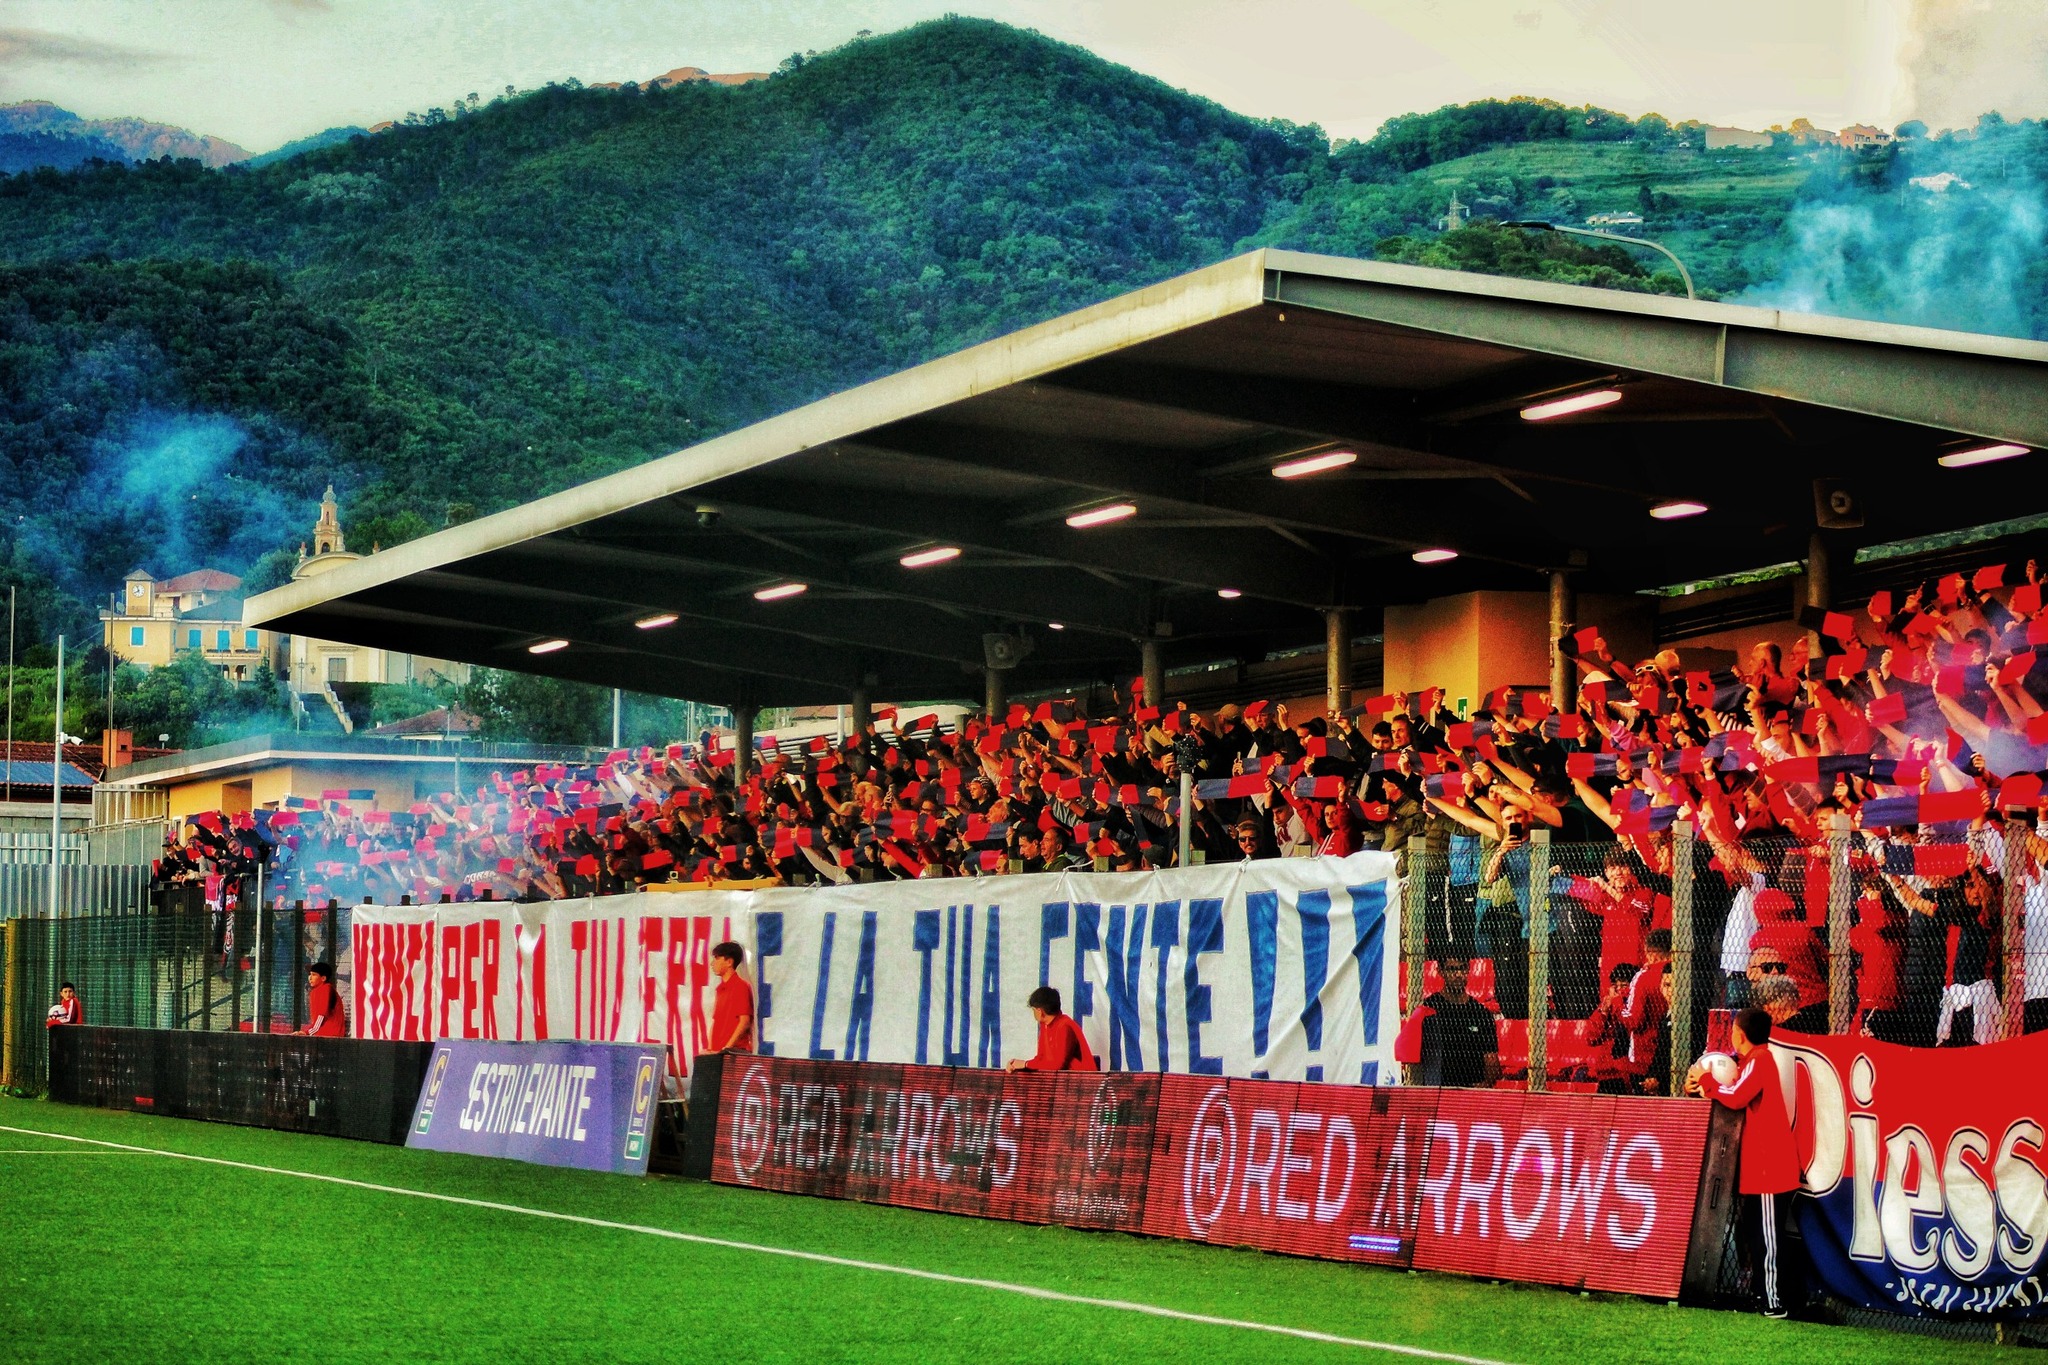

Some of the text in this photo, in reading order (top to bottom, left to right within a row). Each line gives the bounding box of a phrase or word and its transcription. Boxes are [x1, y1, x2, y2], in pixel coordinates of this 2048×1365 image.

[440, 919, 500, 1040] PER
[756, 911, 784, 1056] E
[809, 910, 878, 1062] LA
[912, 903, 1001, 1068] TUA
[773, 1081, 842, 1170] RED
[1238, 1109, 1665, 1252] RED ARROWS
